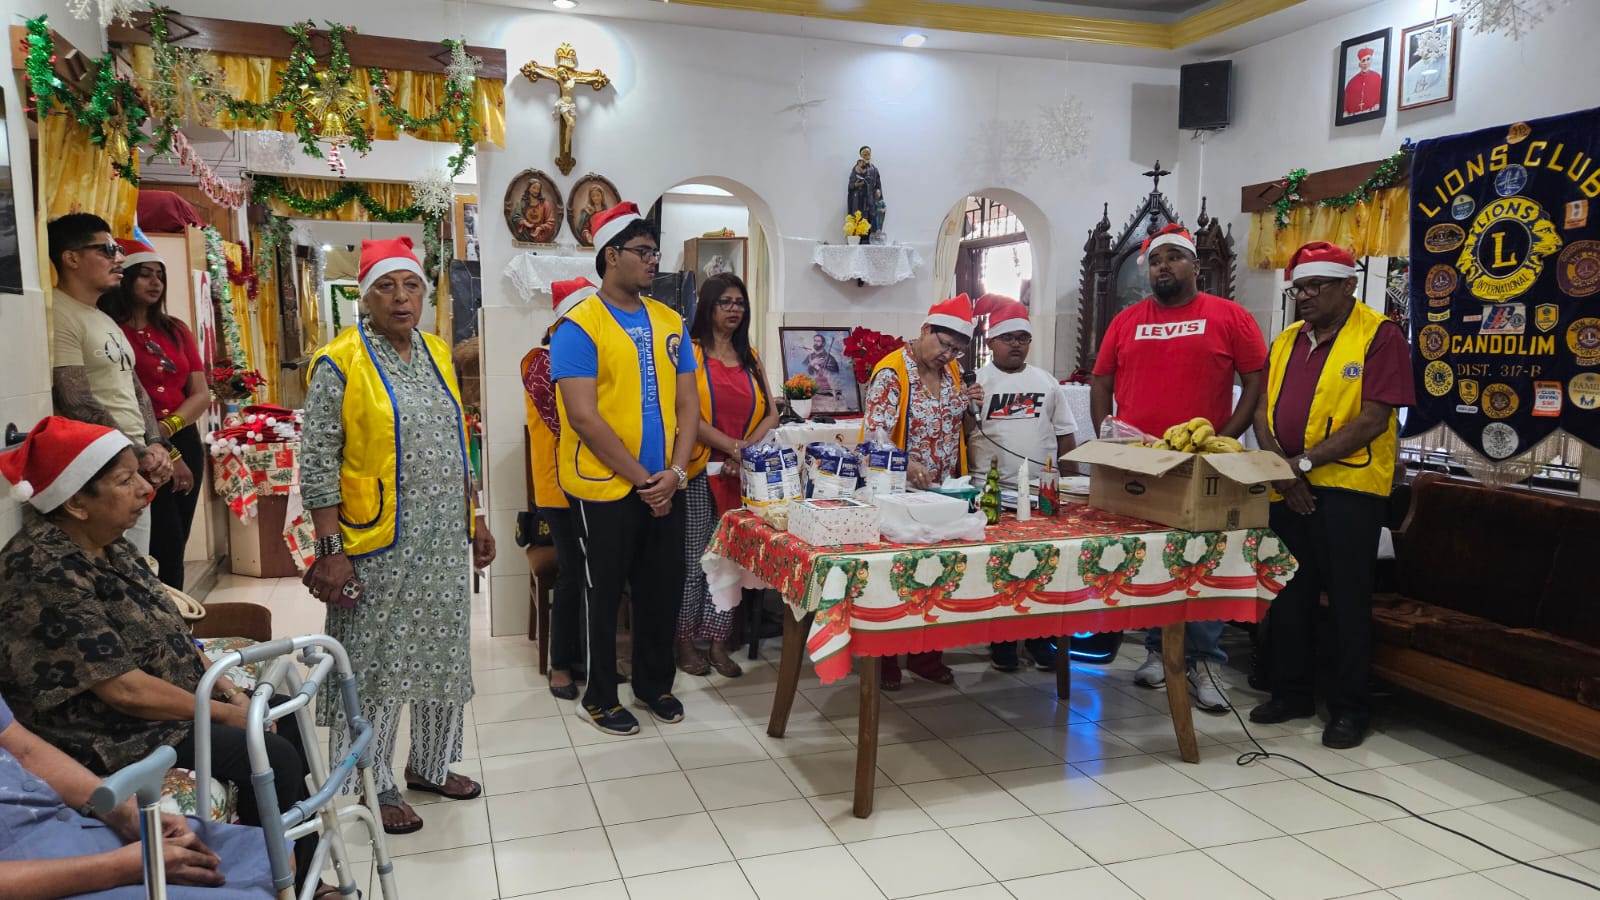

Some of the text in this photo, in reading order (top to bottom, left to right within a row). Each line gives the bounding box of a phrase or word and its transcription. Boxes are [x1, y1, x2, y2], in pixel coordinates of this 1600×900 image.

[1418, 141, 1600, 218] LIONS CLUB
[1477, 202, 1533, 228] LIONS
[1491, 231, 1517, 268] L
[1477, 274, 1530, 294] INTERNATIONAL
[1141, 322, 1199, 336] LEVI'S
[1451, 334, 1555, 355] CANDOLIM
[1457, 363, 1542, 377] DIST. 317-B
[1426, 380, 1452, 395] SPONSOR
[1573, 381, 1600, 391] FAMIL
[986, 392, 1045, 420] NIKE
